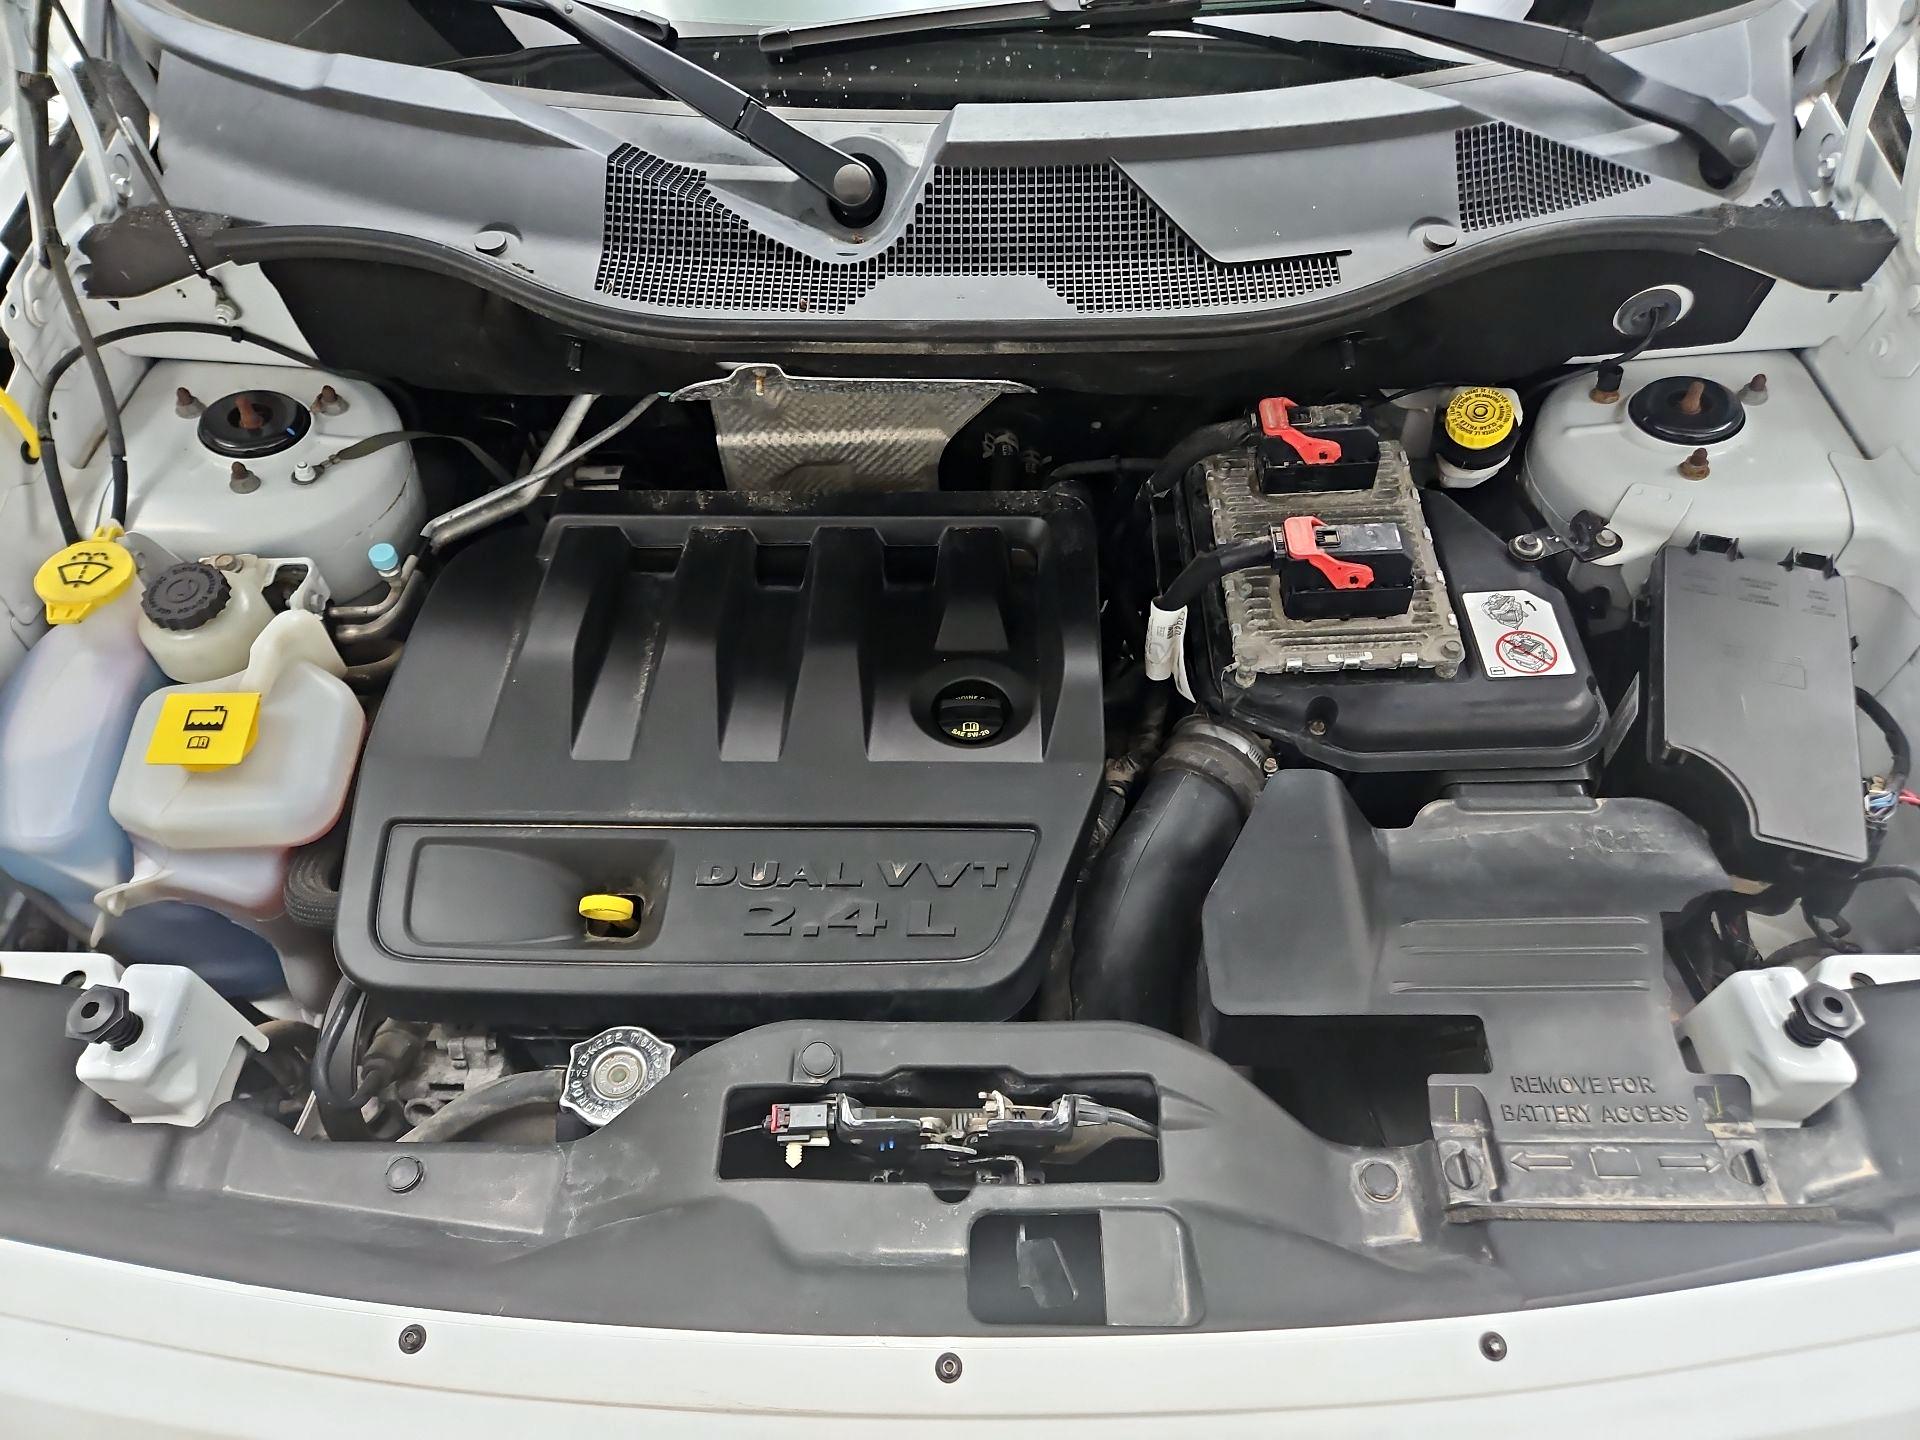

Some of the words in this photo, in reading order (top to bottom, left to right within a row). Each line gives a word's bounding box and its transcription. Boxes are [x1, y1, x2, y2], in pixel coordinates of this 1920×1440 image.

[695, 861, 864, 889] DUAL
[876, 861, 1010, 888] VVT
[1510, 1074, 1602, 1095] REMOVE
[1609, 1075, 1656, 1095] FOR
[1500, 1104, 1592, 1124] BATTERY
[1601, 1104, 1690, 1124] ACCESS
